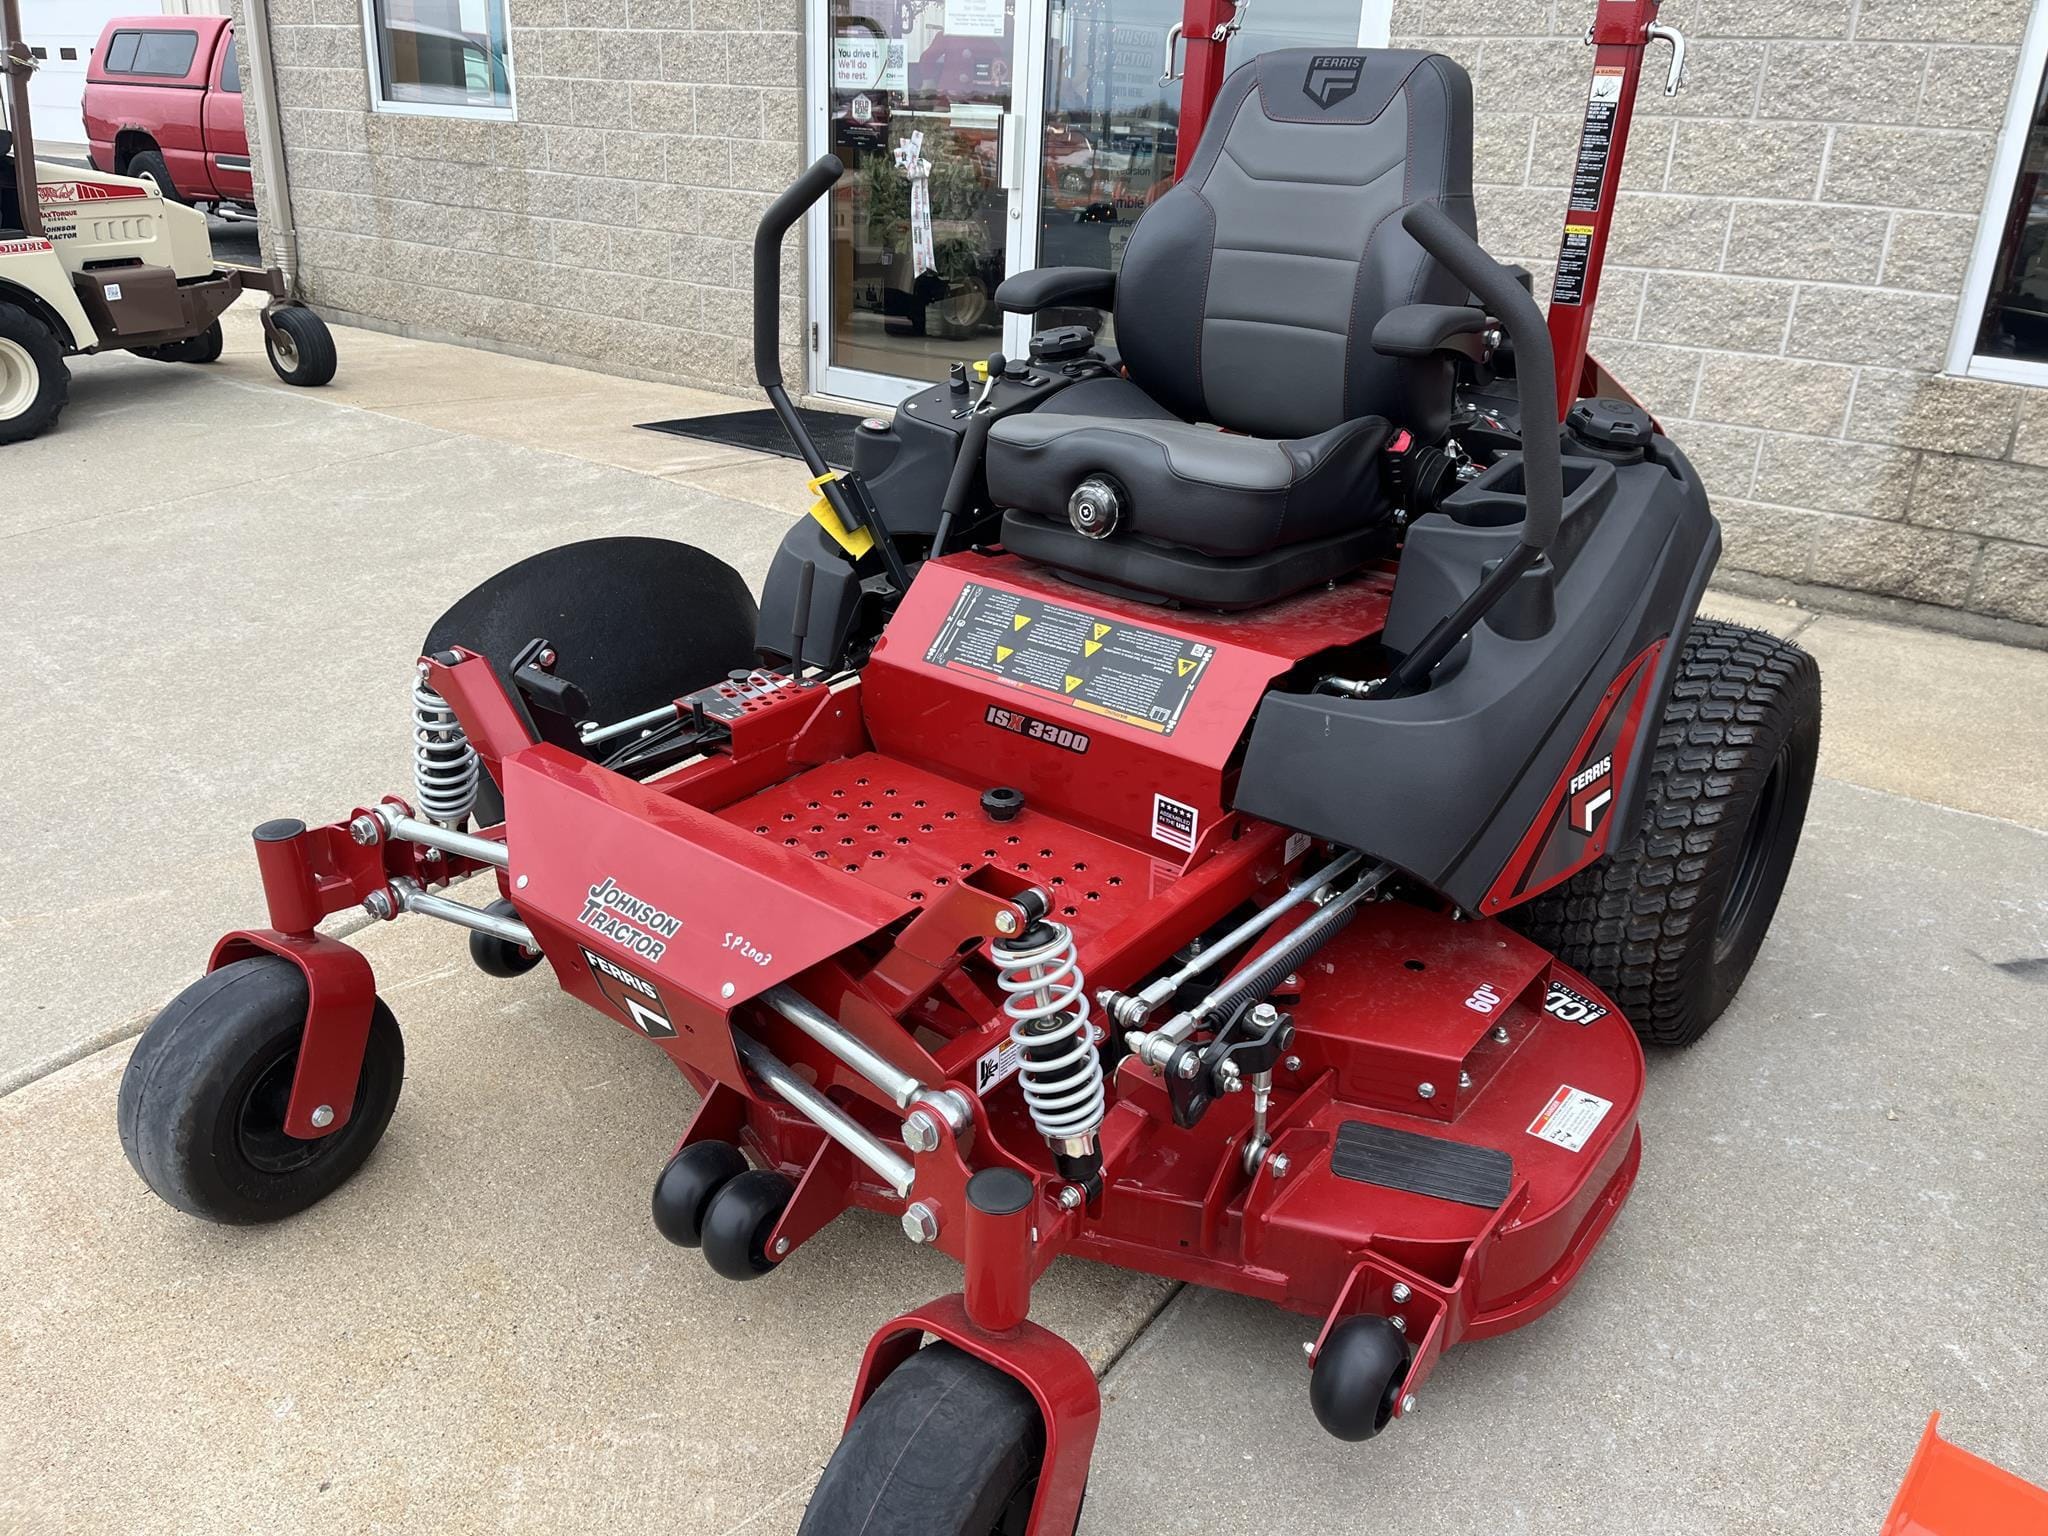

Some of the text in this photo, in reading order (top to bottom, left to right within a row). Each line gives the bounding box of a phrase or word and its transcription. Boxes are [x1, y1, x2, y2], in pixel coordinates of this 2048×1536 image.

[838, 48, 851, 58] You
[852, 48, 870, 58] drive
[838, 60, 867, 69] We'll do
[1314, 57, 1361, 68] FERRIS
[838, 71, 868, 80] the rest.
[986, 706, 1089, 753] ISX 3300
[1570, 755, 1611, 795] FERRIS
[1160, 809, 1191, 826] ASSEMBLED
[1166, 818, 1175, 827] THE
[1175, 822, 1190, 833] USA
[589, 877, 682, 939] JOHNSON
[577, 897, 667, 964] TRACTOR
[721, 932, 773, 967] SP2003
[584, 949, 658, 1000] FERRIS
